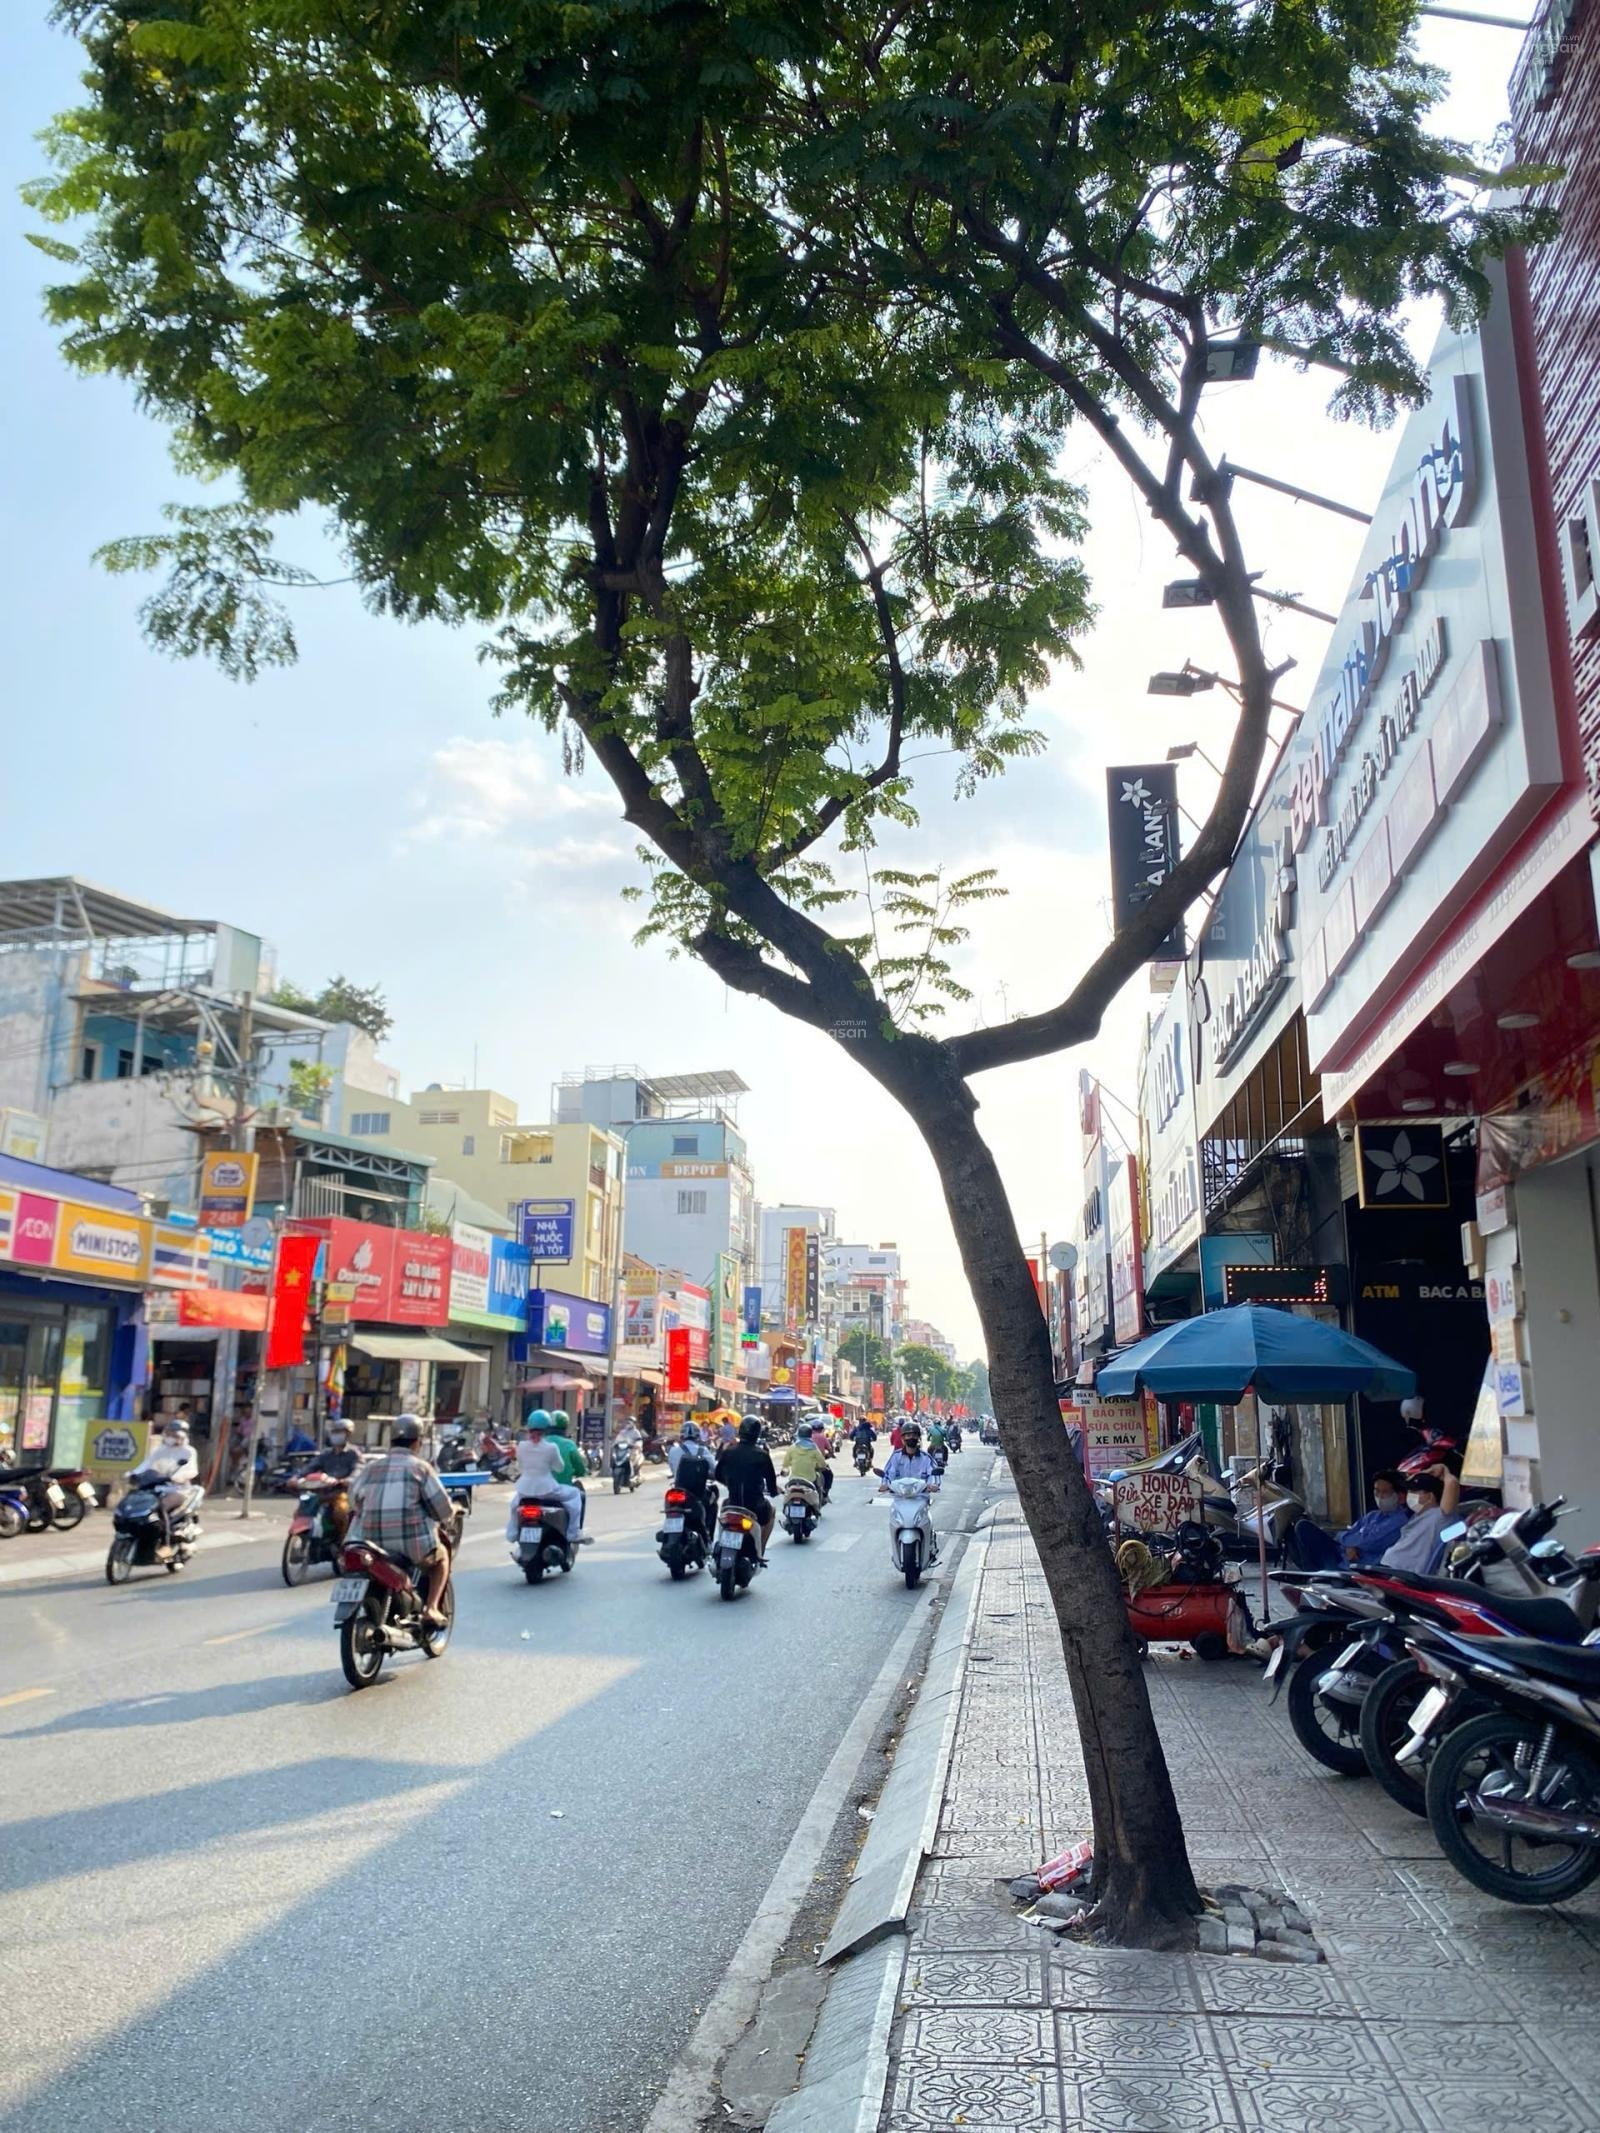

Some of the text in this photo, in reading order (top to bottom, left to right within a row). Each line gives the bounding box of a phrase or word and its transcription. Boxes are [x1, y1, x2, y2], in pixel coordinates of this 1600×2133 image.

[673, 1164, 718, 1177] DEPOT
[76, 1232, 140, 1259] MINISTOP
[494, 1257, 530, 1301] INAX
[1362, 1285, 1399, 1299] ATM
[1419, 1285, 1453, 1299] BAC
[1456, 1285, 1469, 1299] A
[627, 1301, 640, 1318] 7
[1095, 1432, 1136, 1445] XE MÁY
[1141, 1474, 1192, 1495] HONDA
[1141, 1492, 1162, 1509] XE
